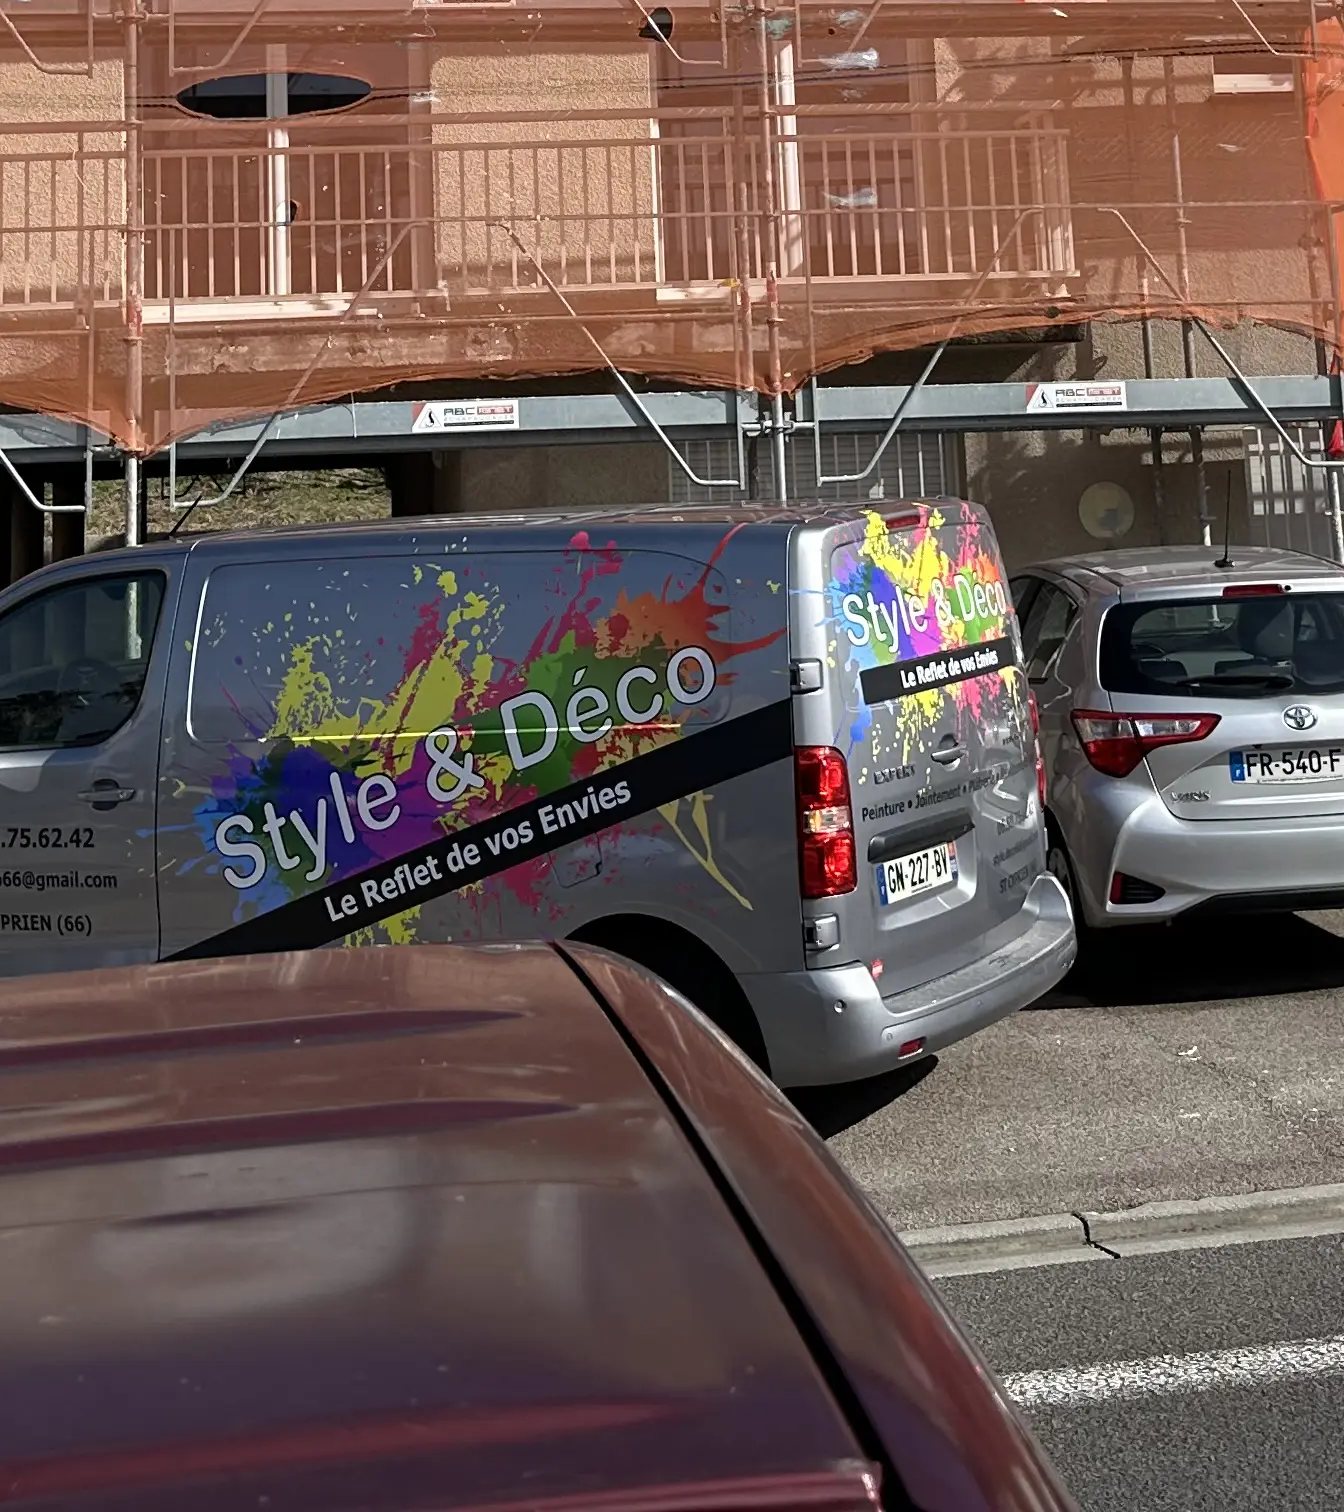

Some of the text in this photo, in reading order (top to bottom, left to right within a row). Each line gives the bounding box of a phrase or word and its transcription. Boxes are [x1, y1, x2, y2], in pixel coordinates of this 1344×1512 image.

[842, 584, 928, 654] Style
[930, 576, 956, 627] &
[900, 669, 915, 689] Le
[917, 660, 947, 686] Reflet
[949, 657, 961, 675] de
[961, 655, 976, 673] vos
[214, 645, 716, 890] Style & Déco
[862, 800, 905, 822] Peinture
[915, 787, 961, 809] Jointement
[324, 779, 633, 923] Le Reflet de vos Envies
[887, 845, 948, 894] GN-227-BV
[57, 914, 92, 936] (66)
